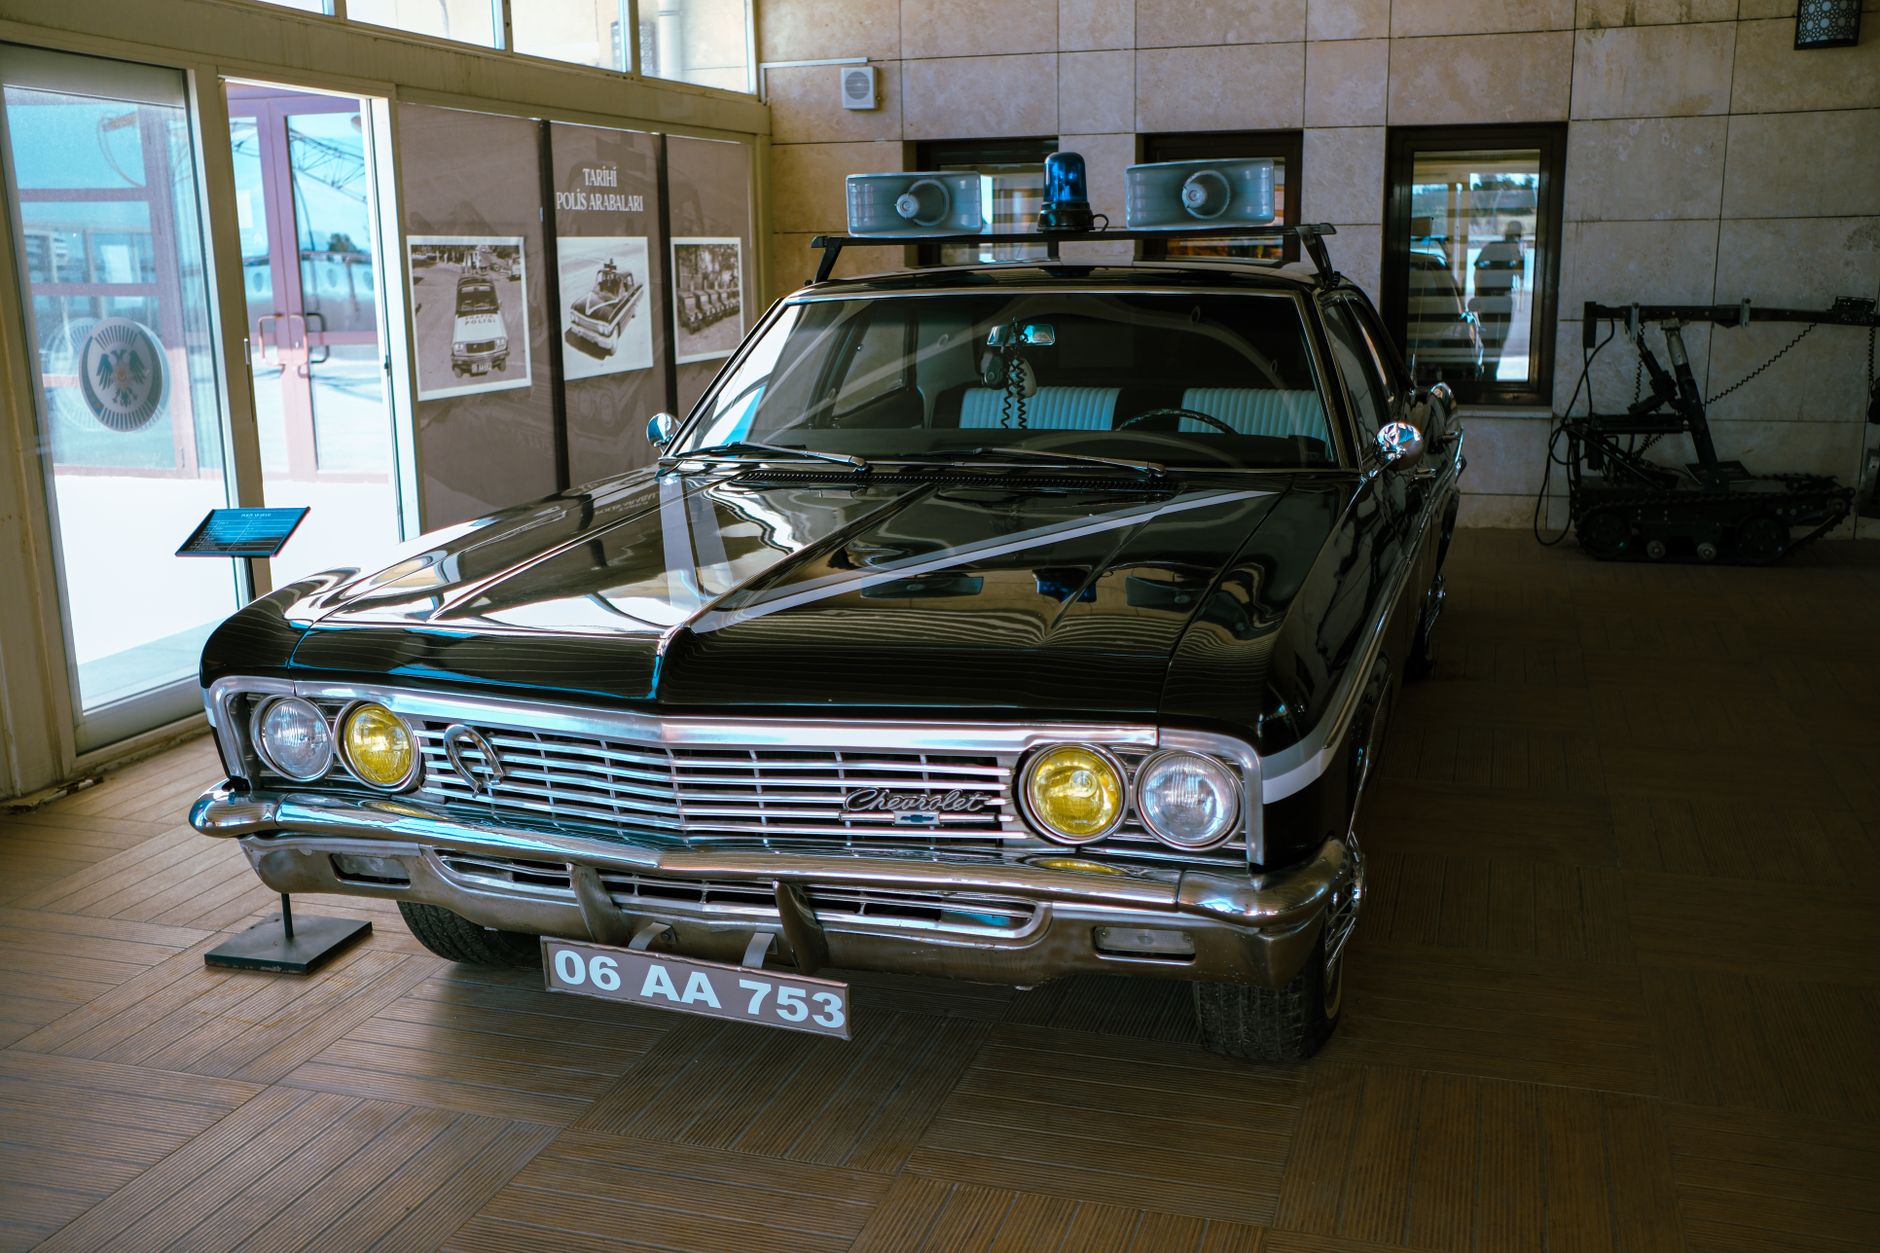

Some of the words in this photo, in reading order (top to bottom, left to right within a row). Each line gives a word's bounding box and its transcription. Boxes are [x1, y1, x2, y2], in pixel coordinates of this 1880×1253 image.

[582, 165, 618, 187] TARİHİ
[556, 188, 587, 210] POLİS
[588, 193, 644, 212] ARABALARI
[844, 786, 992, 812] Chevrolet
[554, 949, 622, 991] 06
[639, 964, 722, 1009] AA
[738, 978, 846, 1028] 753
